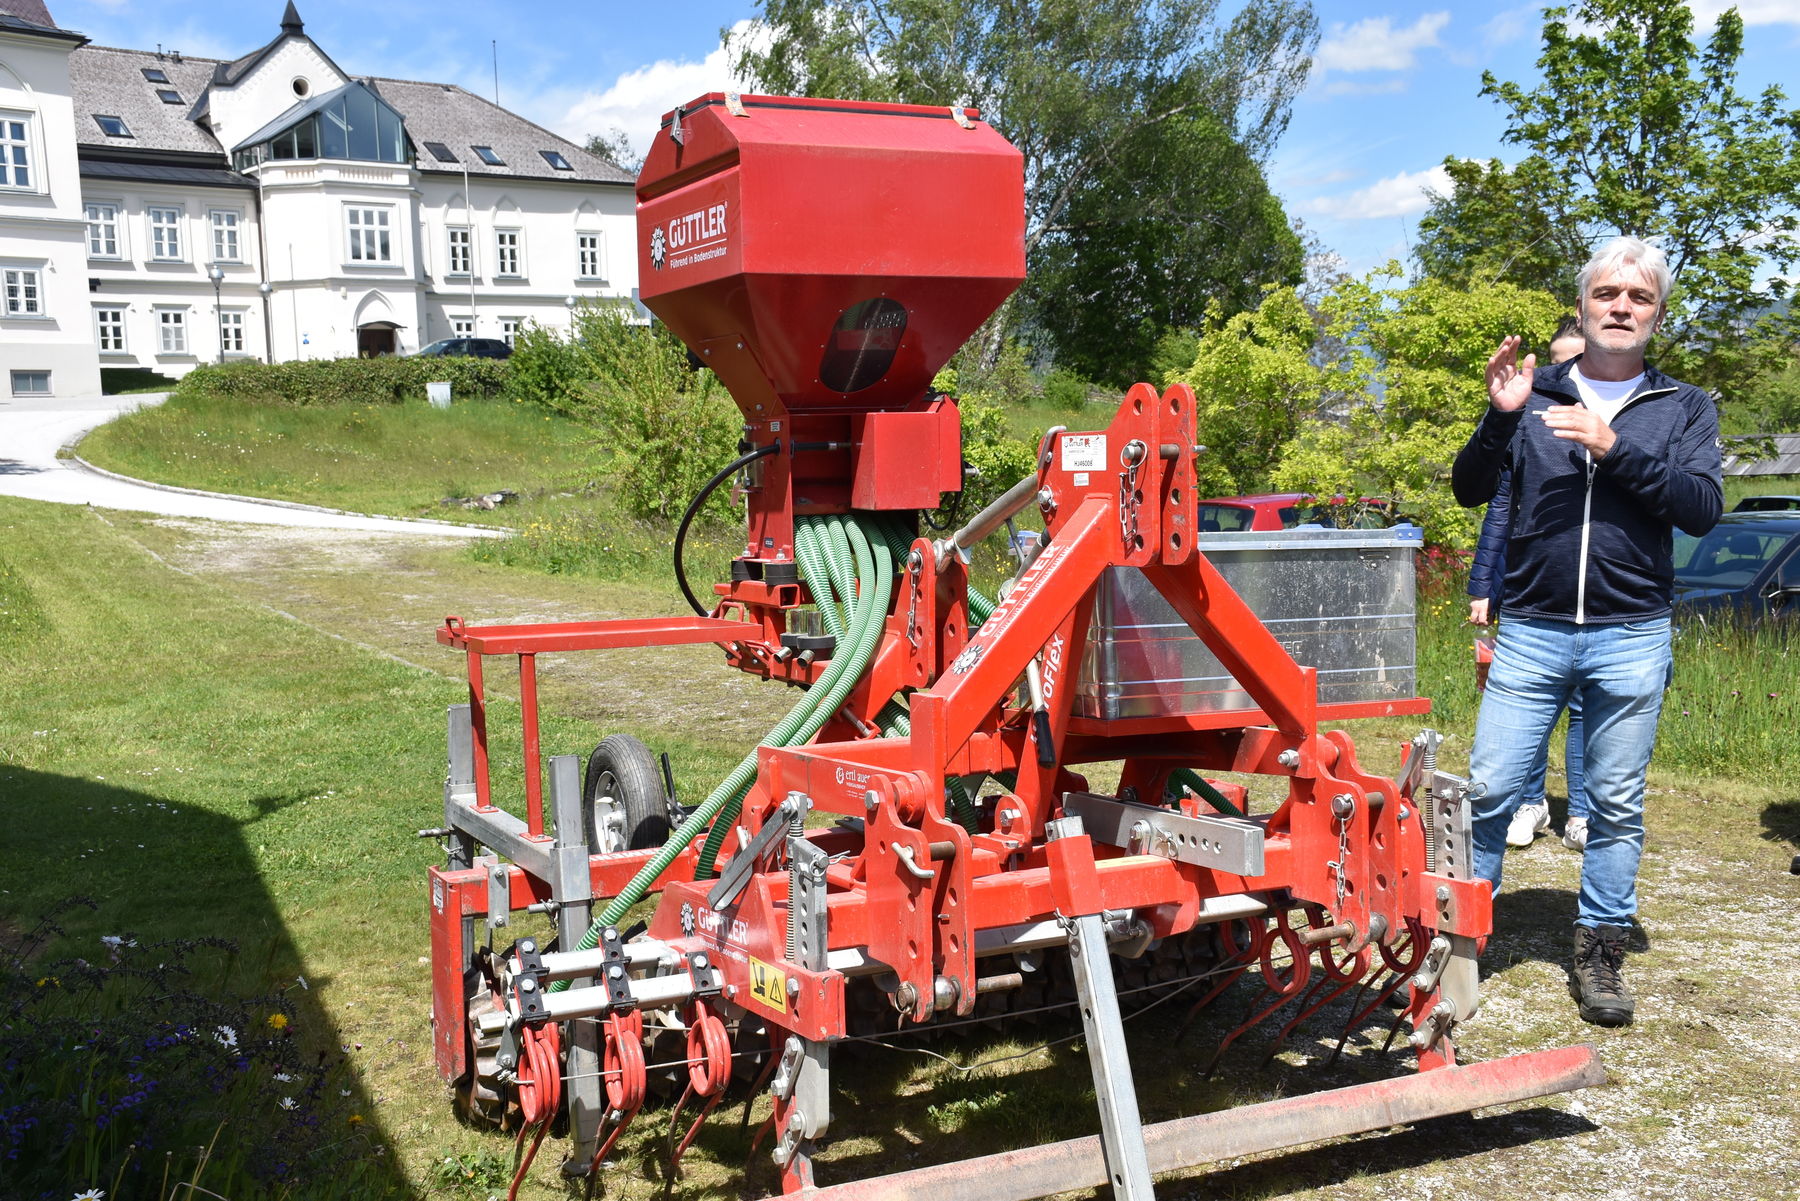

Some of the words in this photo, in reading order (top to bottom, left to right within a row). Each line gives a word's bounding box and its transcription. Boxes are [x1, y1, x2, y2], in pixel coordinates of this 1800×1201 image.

[669, 204, 726, 248] GÜTTLER
[670, 256, 688, 269] Führend
[694, 247, 727, 262] Bodenstruktur
[979, 545, 1058, 637] GÜTTLER
[698, 907, 748, 945] GÜTTLER
